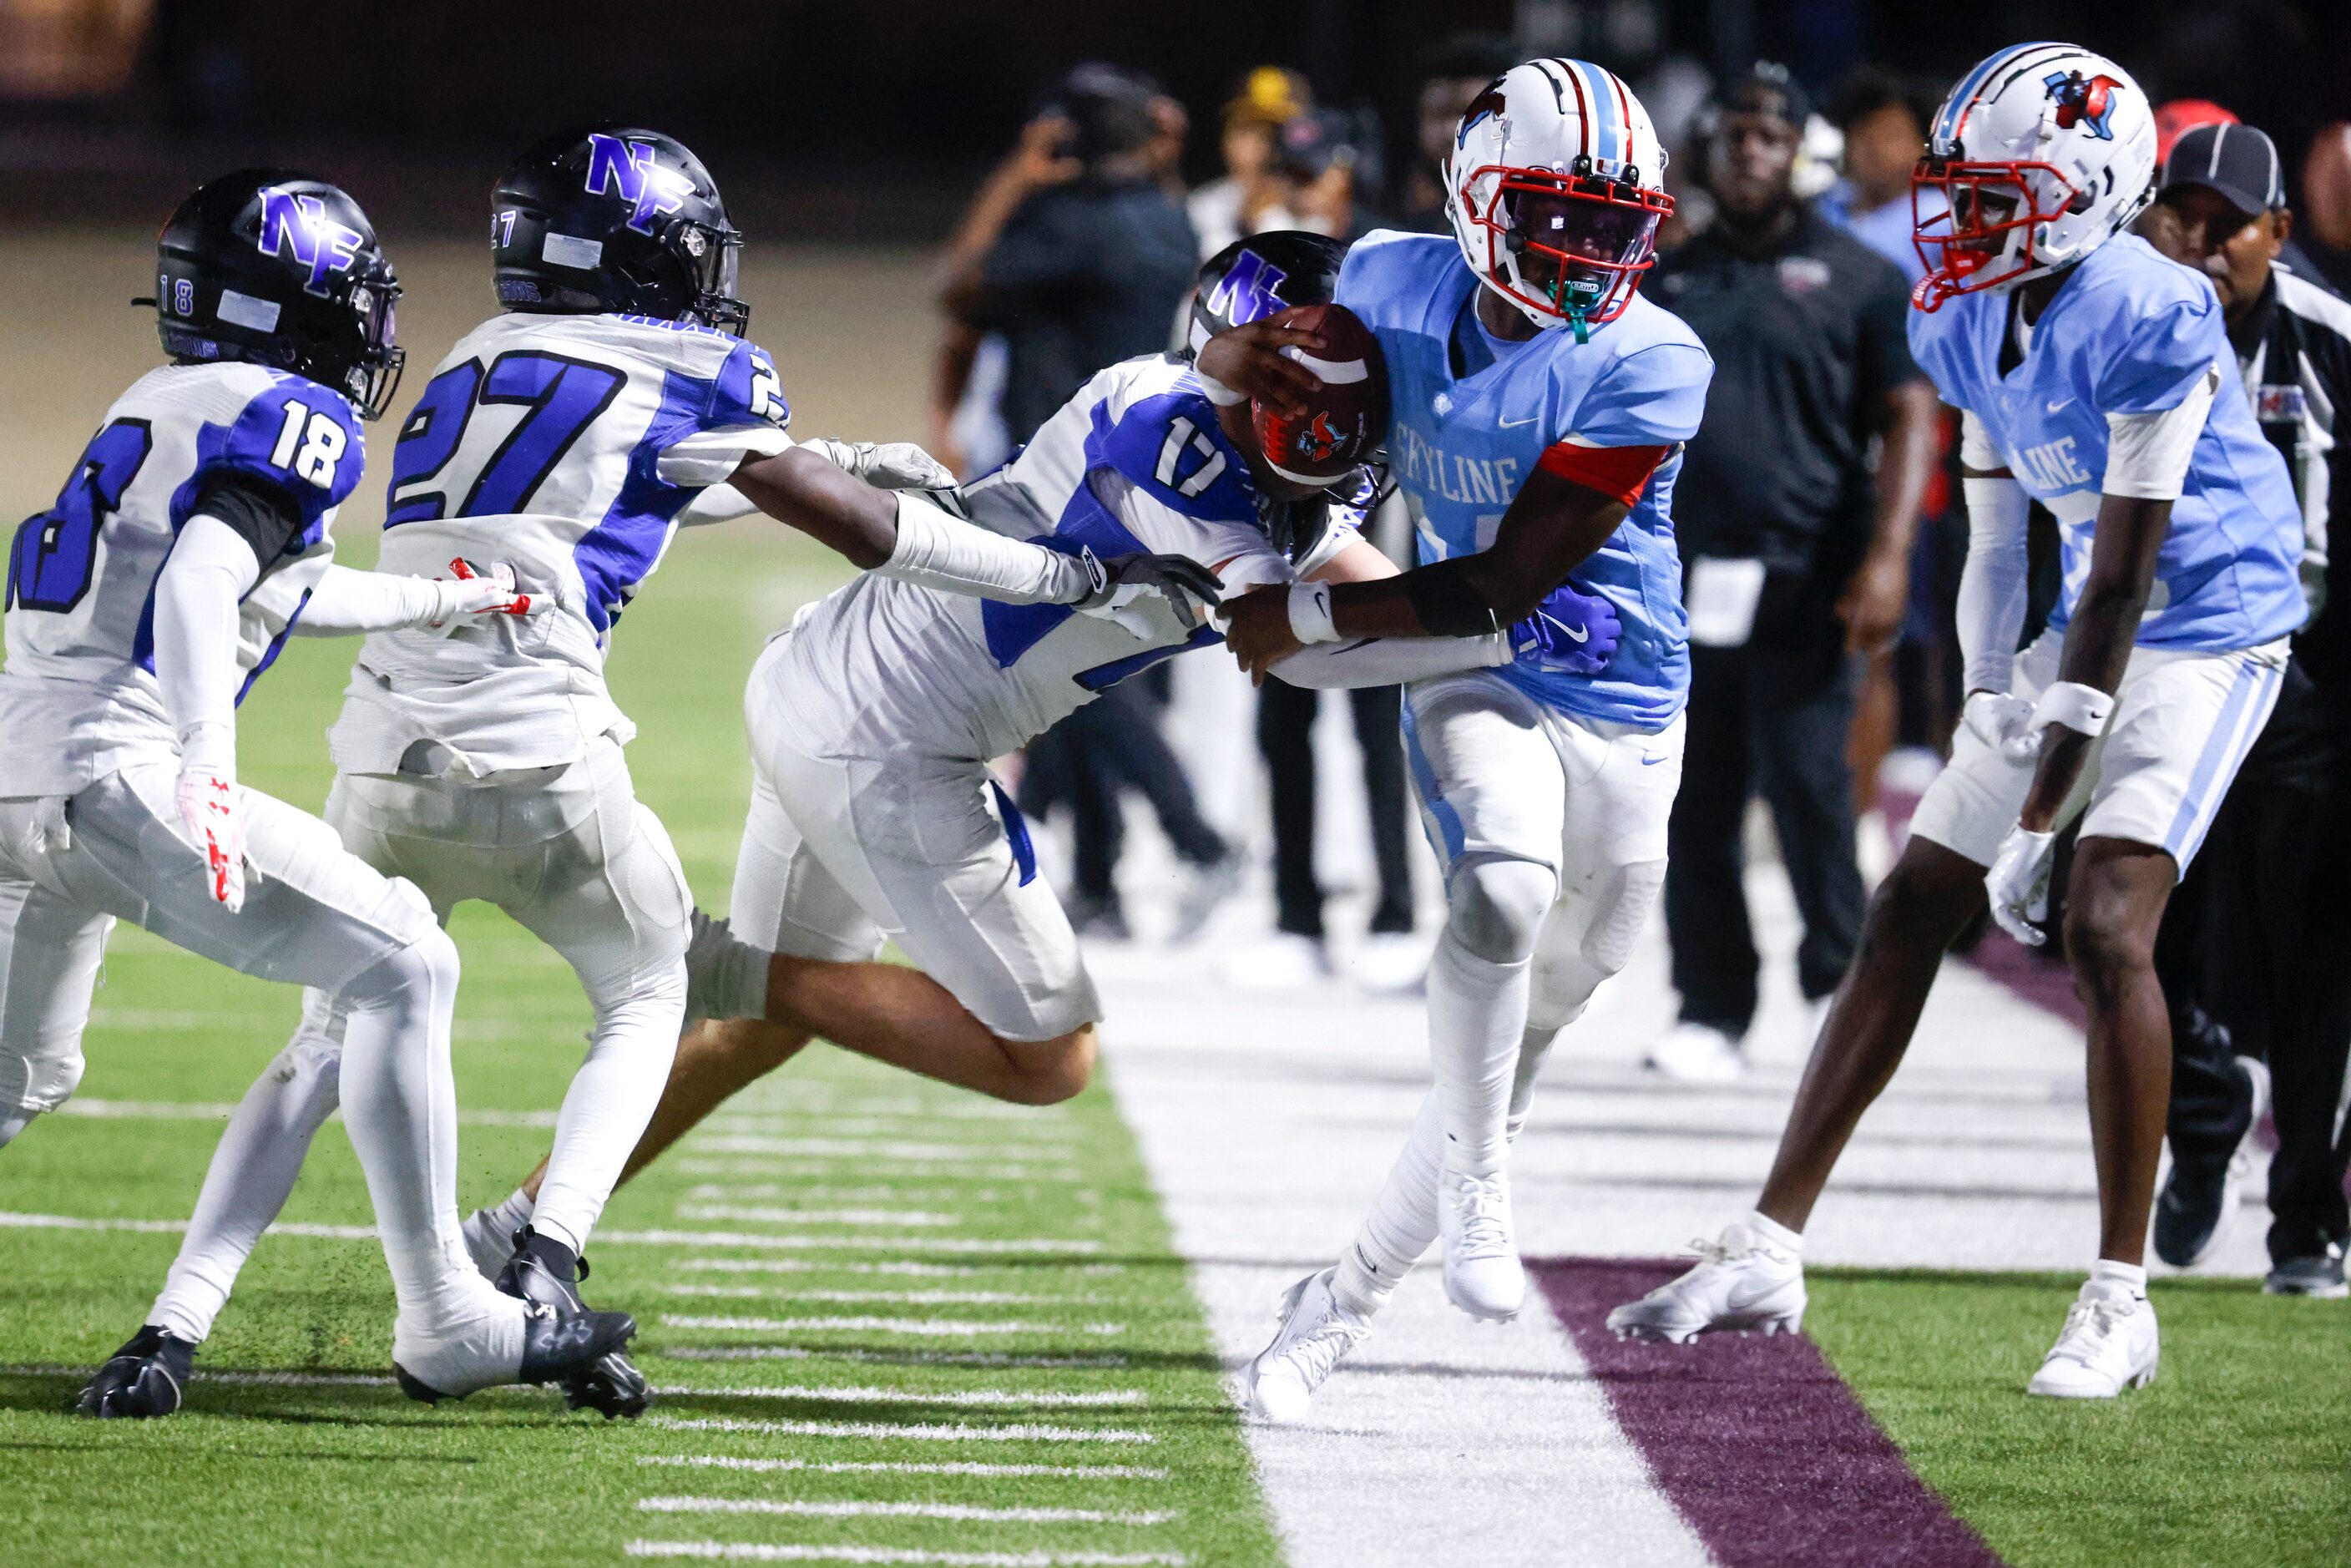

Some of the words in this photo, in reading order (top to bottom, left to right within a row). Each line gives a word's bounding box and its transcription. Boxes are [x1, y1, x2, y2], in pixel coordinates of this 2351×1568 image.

[584, 133, 696, 237] NF
[257, 187, 364, 300] NF
[160, 274, 193, 316] 18
[749, 352, 792, 427] 2
[269, 398, 348, 490] 18
[383, 349, 628, 531] 27
[1154, 415, 1227, 498] 17
[1392, 420, 1519, 506] SKYLINE
